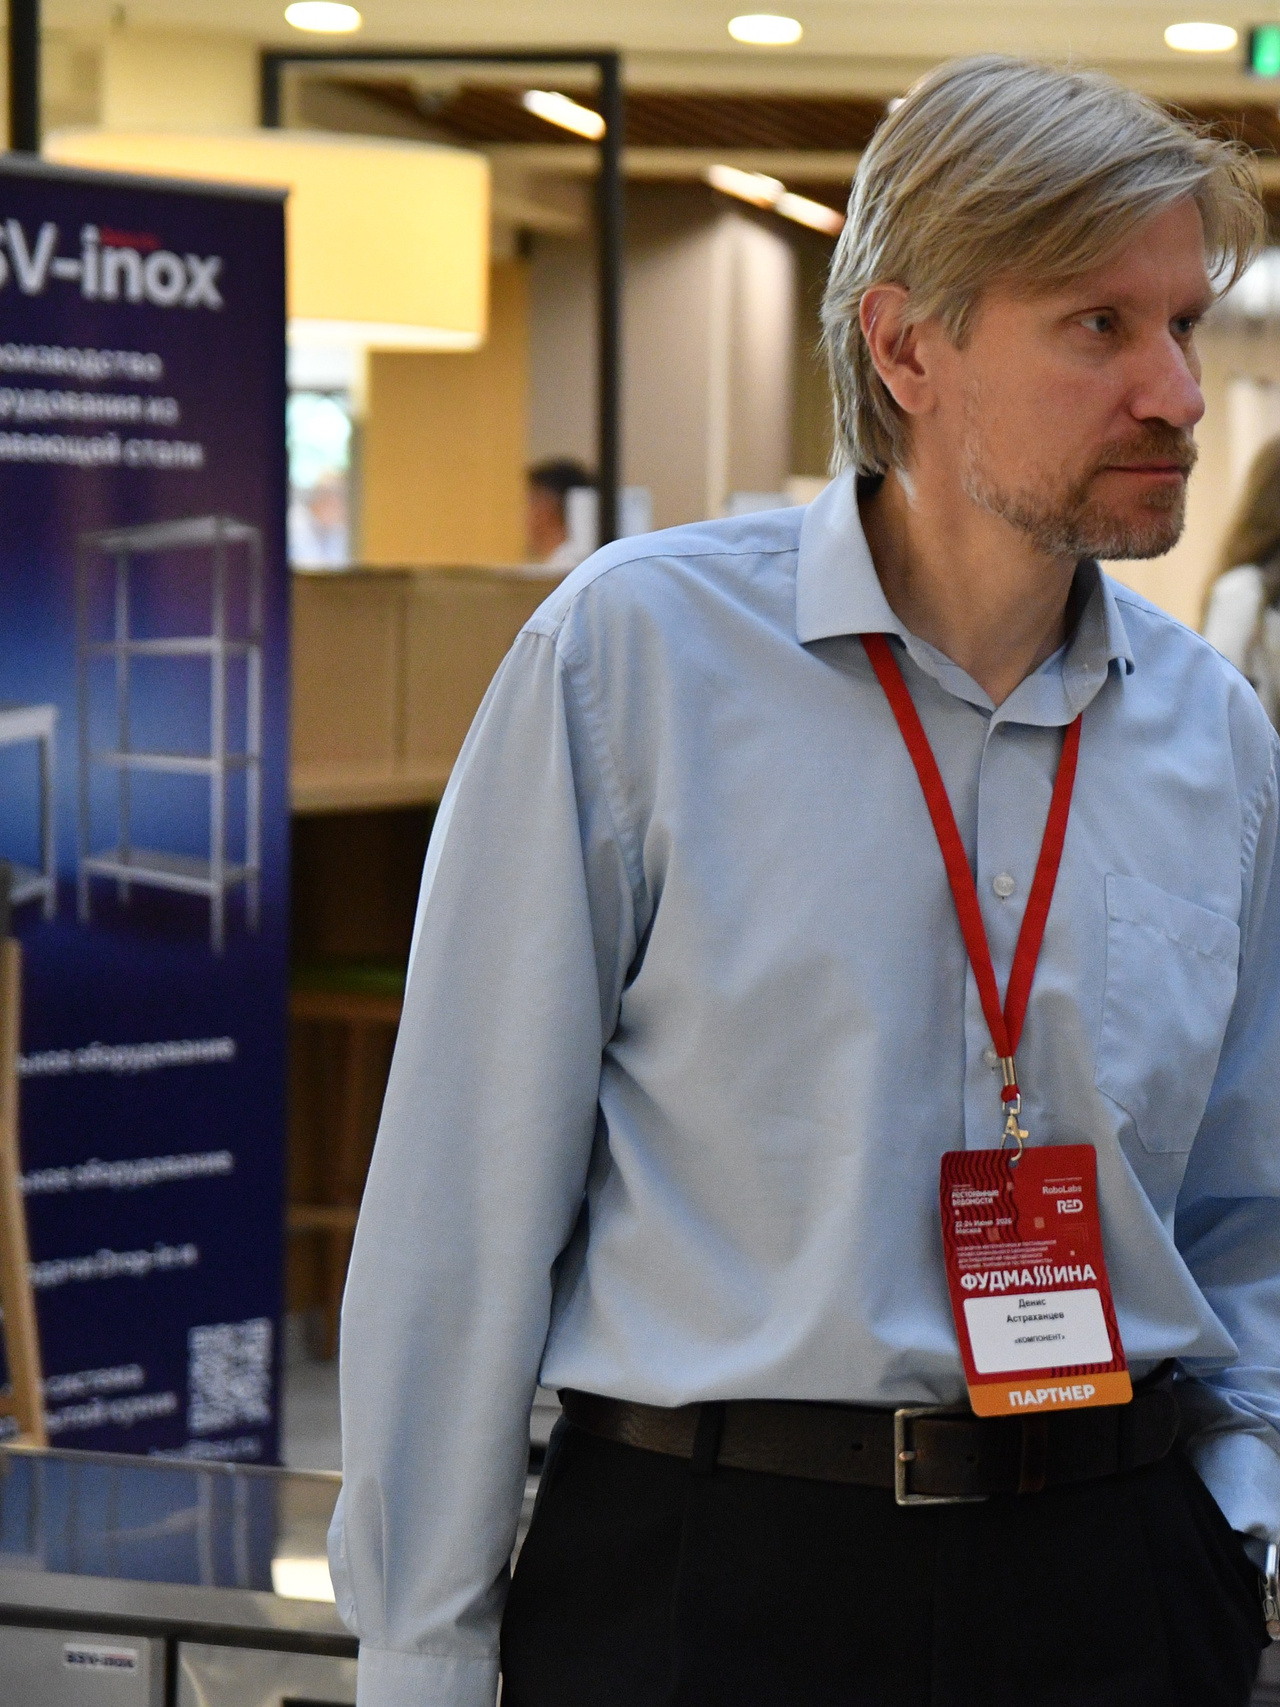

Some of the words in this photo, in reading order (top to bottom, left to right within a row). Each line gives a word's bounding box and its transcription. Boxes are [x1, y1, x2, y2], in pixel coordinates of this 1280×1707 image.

[123, 438, 204, 470] стали
[73, 1036, 236, 1075] оборудование
[72, 1150, 234, 1189] оборудование
[1042, 1184, 1082, 1195] RoboLabs
[1057, 1199, 1083, 1214] RED
[1018, 1298, 1046, 1309] Денис
[1006, 1311, 1064, 1324] Астраханцев
[1008, 1384, 1096, 1407] ПАРТНЕР
